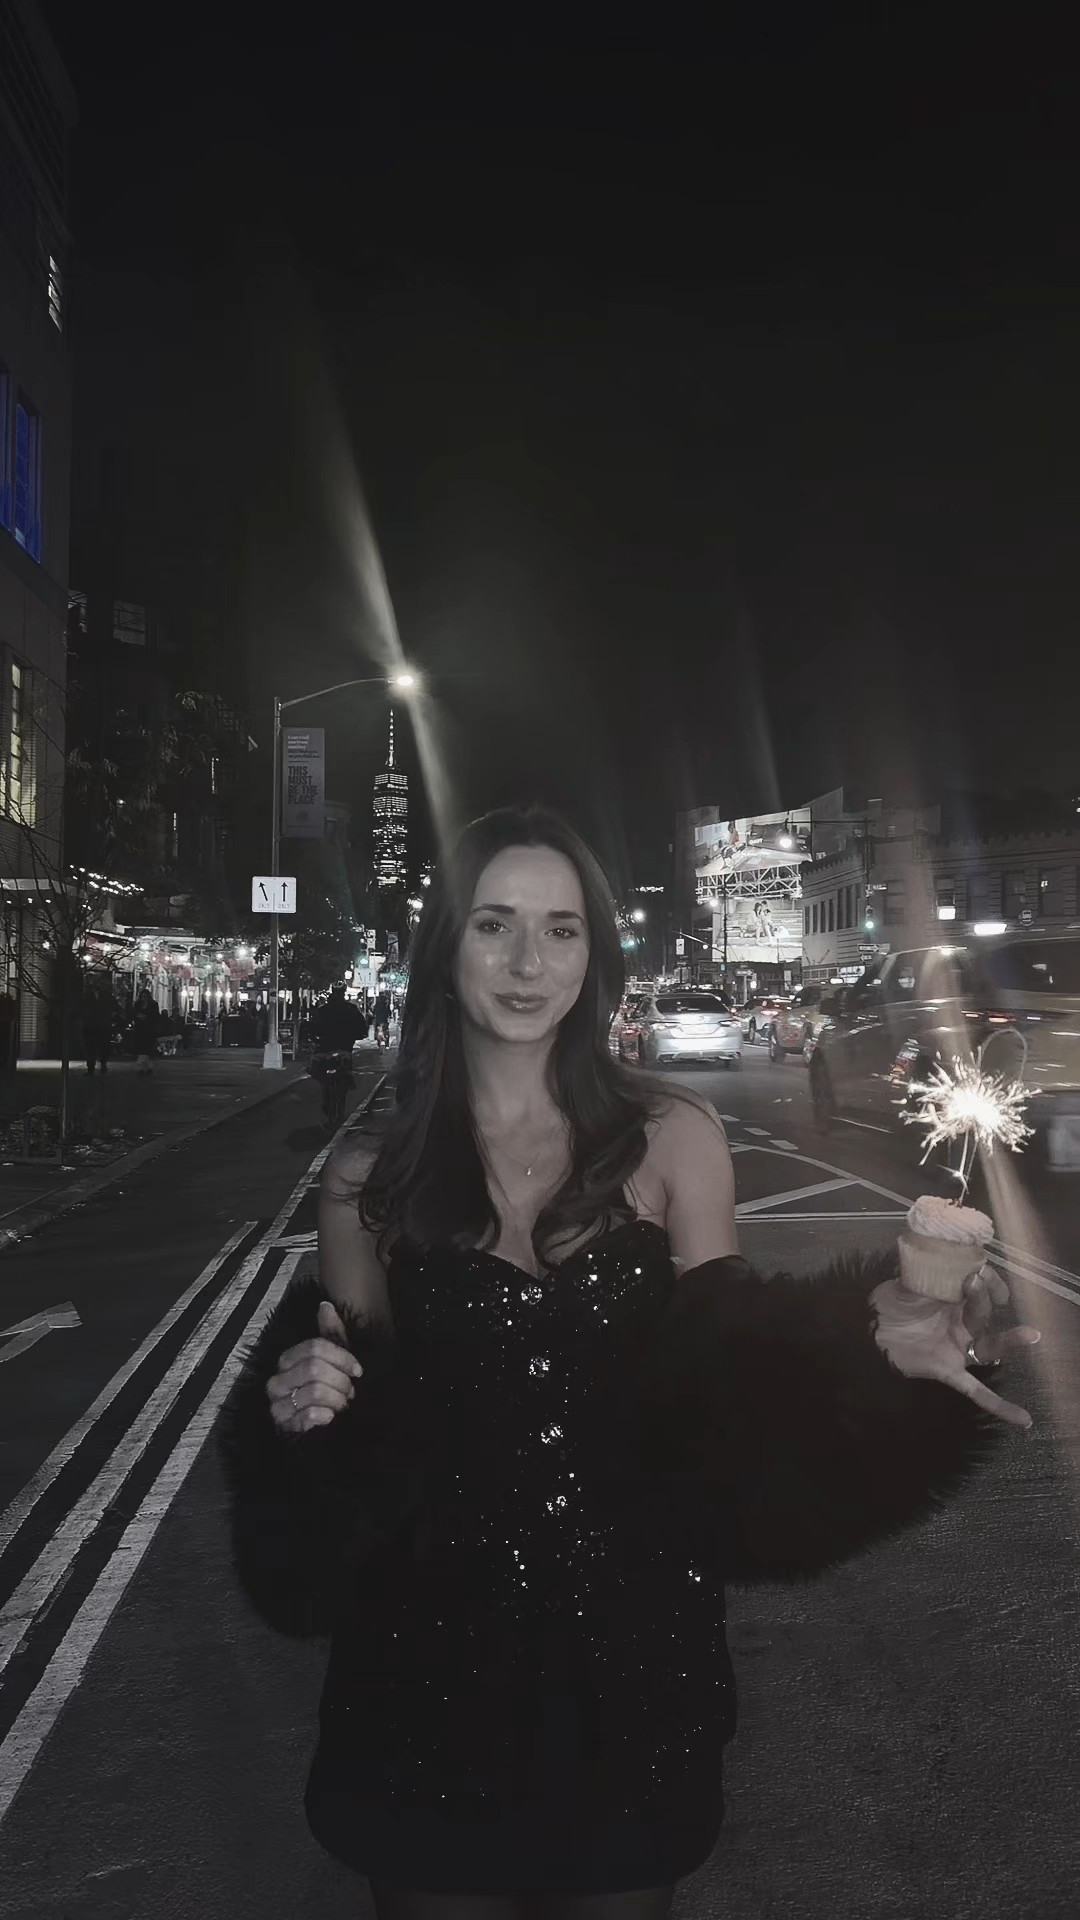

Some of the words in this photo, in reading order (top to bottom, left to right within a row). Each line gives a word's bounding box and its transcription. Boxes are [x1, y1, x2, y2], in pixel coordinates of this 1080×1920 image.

[288, 766, 308, 776] THIS
[288, 776, 313, 786] MUST
[288, 786, 299, 795] BE
[302, 786, 319, 795] THE
[288, 795, 315, 805] PLACE
